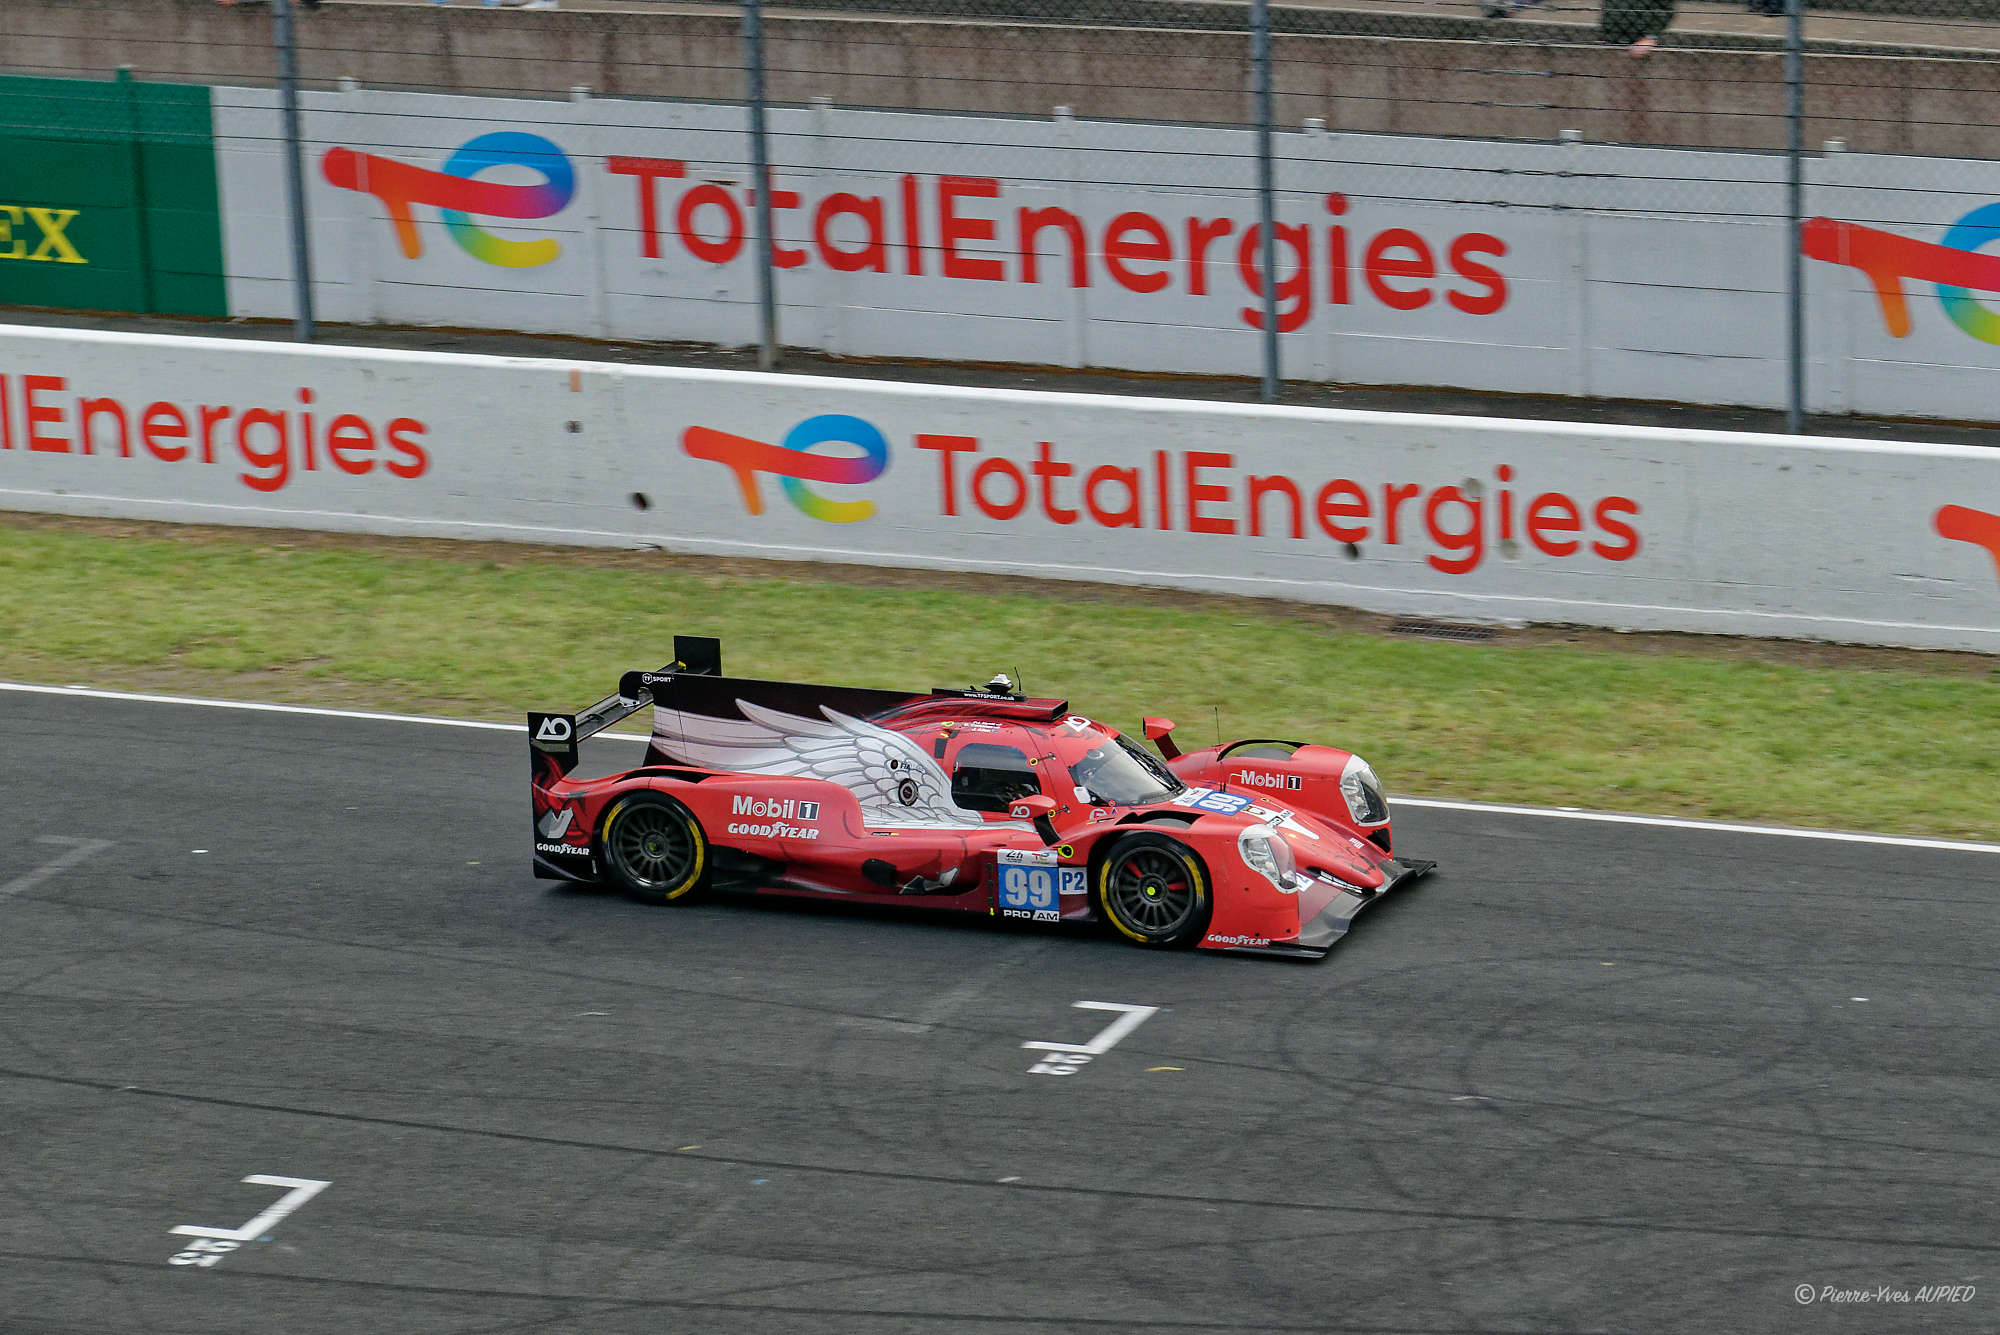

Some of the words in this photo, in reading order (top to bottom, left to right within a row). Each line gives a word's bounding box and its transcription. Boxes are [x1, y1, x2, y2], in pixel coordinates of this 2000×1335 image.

[605, 154, 1510, 334] TotalEnergies
[914, 432, 1641, 576] TotalEnergies
[1240, 769, 1285, 789] Mobil
[732, 794, 795, 819] Mobil
[1198, 792, 1247, 813] 99
[728, 821, 819, 840] GOODYEAR
[536, 842, 590, 856] GOODYEAR
[1005, 868, 1052, 908] 99
[1061, 871, 1085, 892] P2
[1003, 909, 1031, 919] PRO
[1037, 912, 1059, 921] AM
[1207, 934, 1270, 946] GOODYEAR
